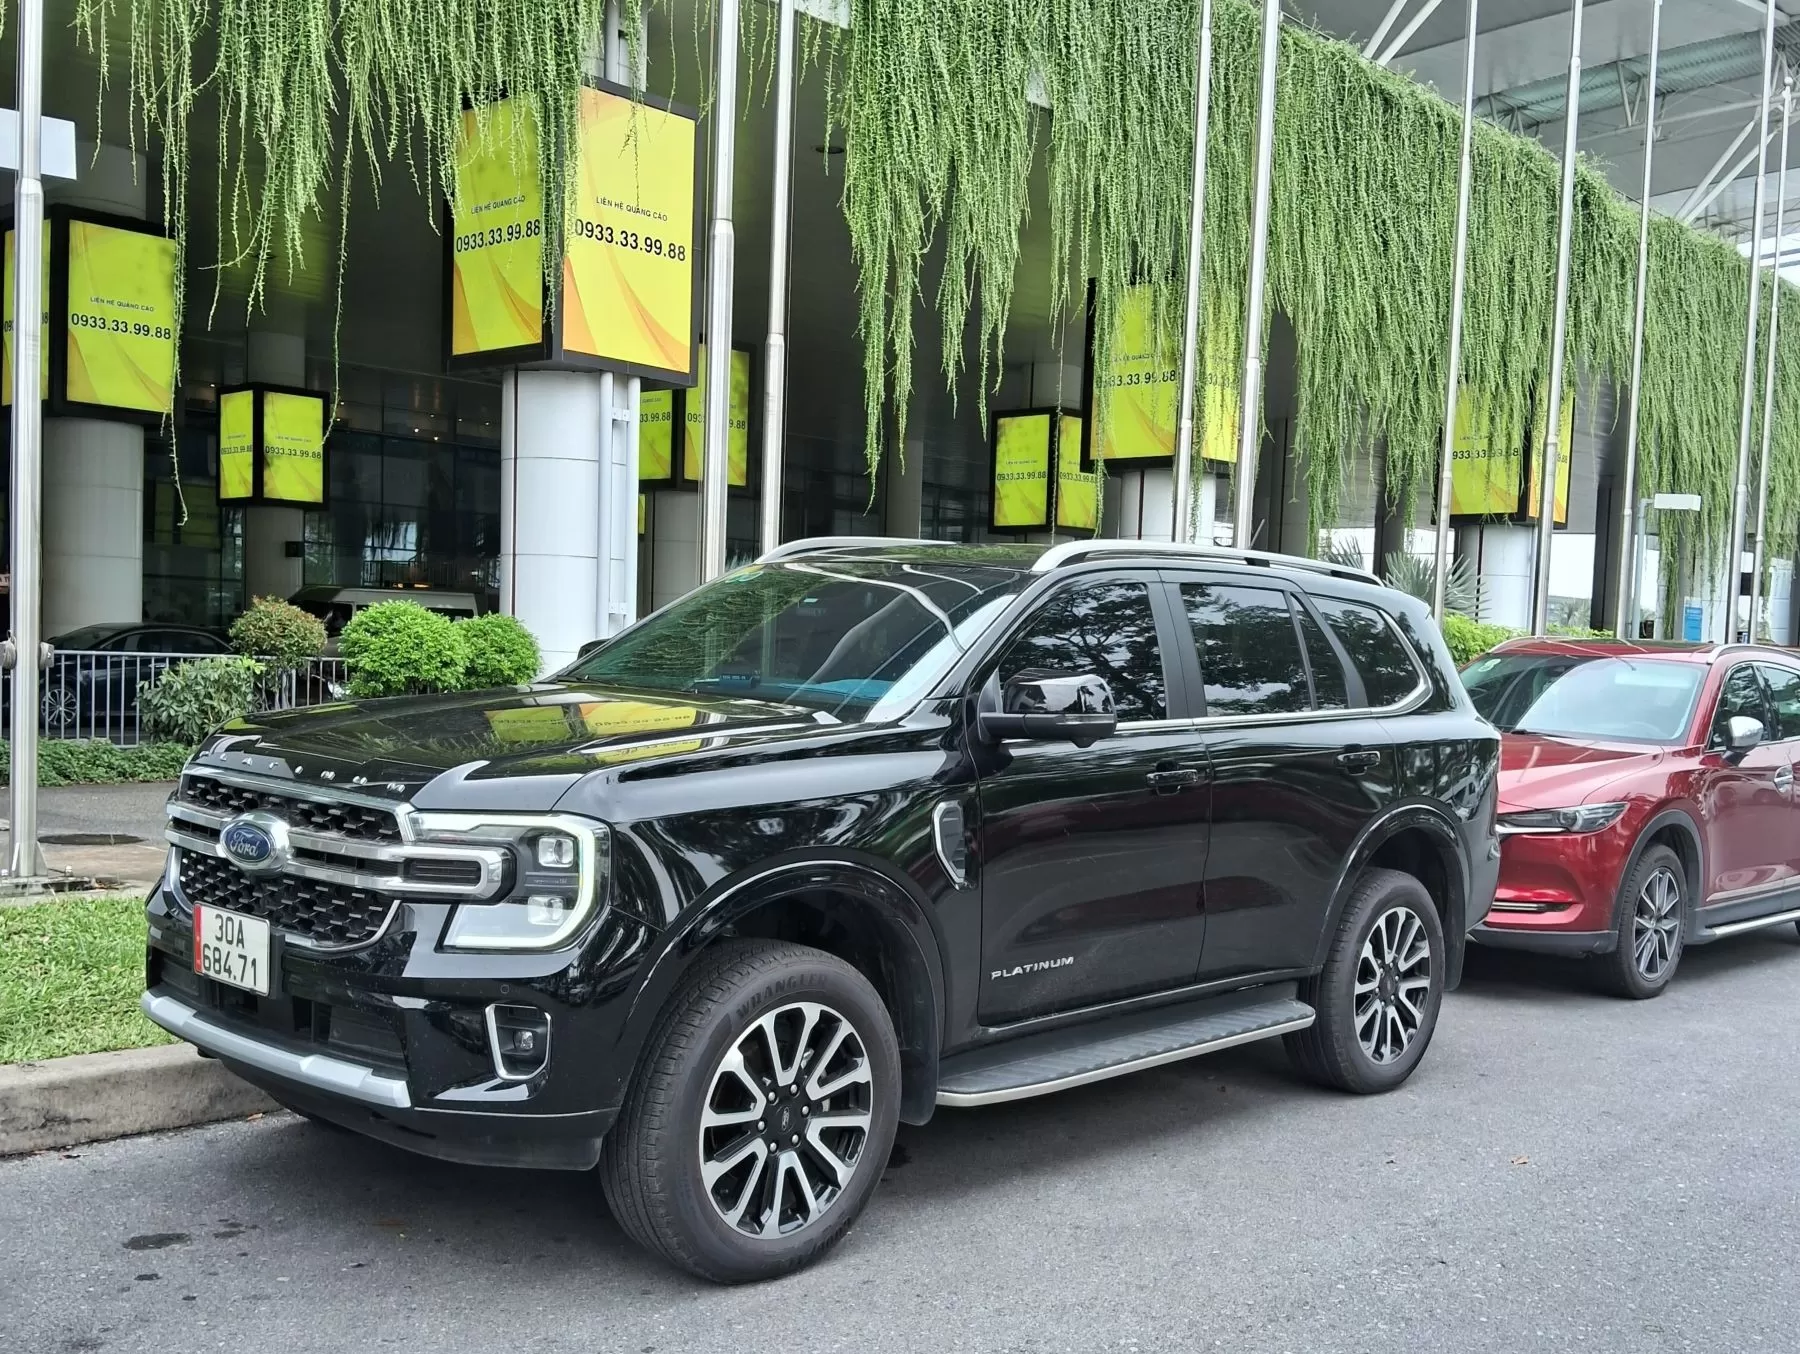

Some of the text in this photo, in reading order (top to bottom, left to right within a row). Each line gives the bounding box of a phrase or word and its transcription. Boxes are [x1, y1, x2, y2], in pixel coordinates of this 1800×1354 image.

[456, 218, 541, 253] 0933.33.99.88
[575, 218, 686, 262] 0933.33.99.88
[71, 313, 172, 340] 0933.33.99.88
[229, 830, 261, 857] Ford
[214, 914, 245, 949] 30A
[202, 943, 257, 987] 684.71
[990, 956, 1075, 981] PLATINUM
